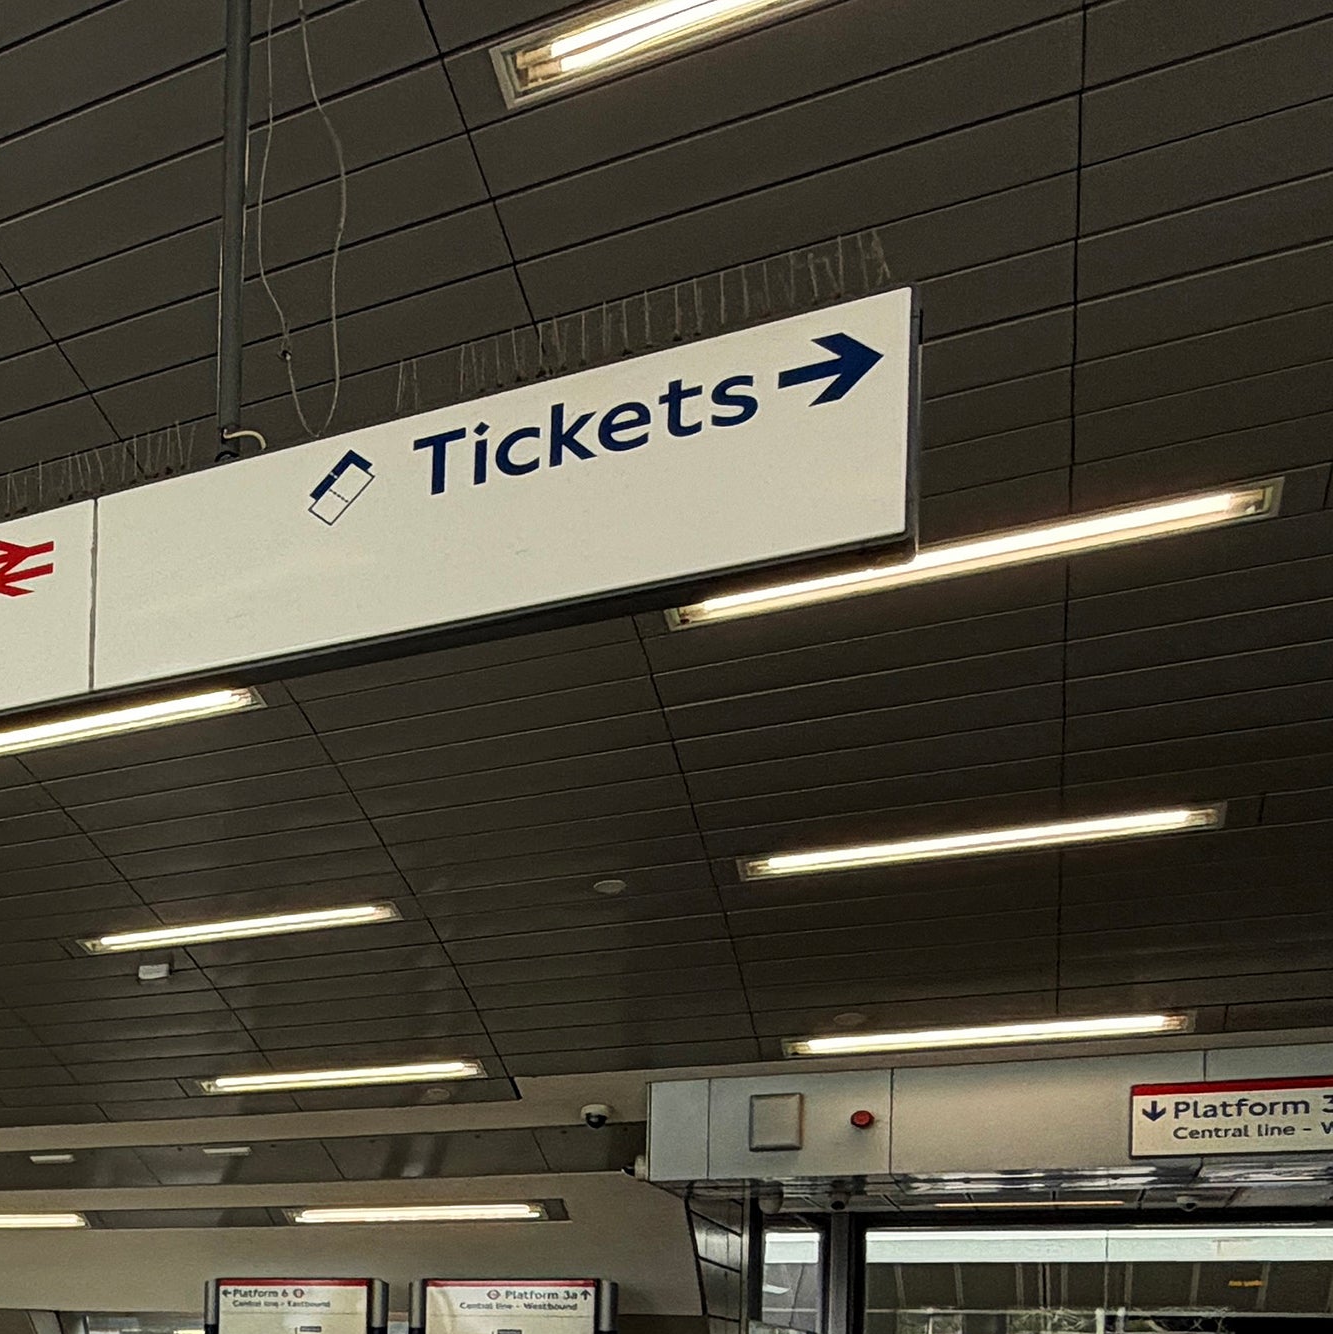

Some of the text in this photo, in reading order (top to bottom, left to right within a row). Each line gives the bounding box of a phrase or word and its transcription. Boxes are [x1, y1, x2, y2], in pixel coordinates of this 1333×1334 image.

[413, 375, 758, 496] Tickets
[1174, 1098, 1310, 1120] Platform
[1173, 1123, 1295, 1140] Central line
[233, 1289, 278, 1298] Platform
[505, 1290, 559, 1300] Platform
